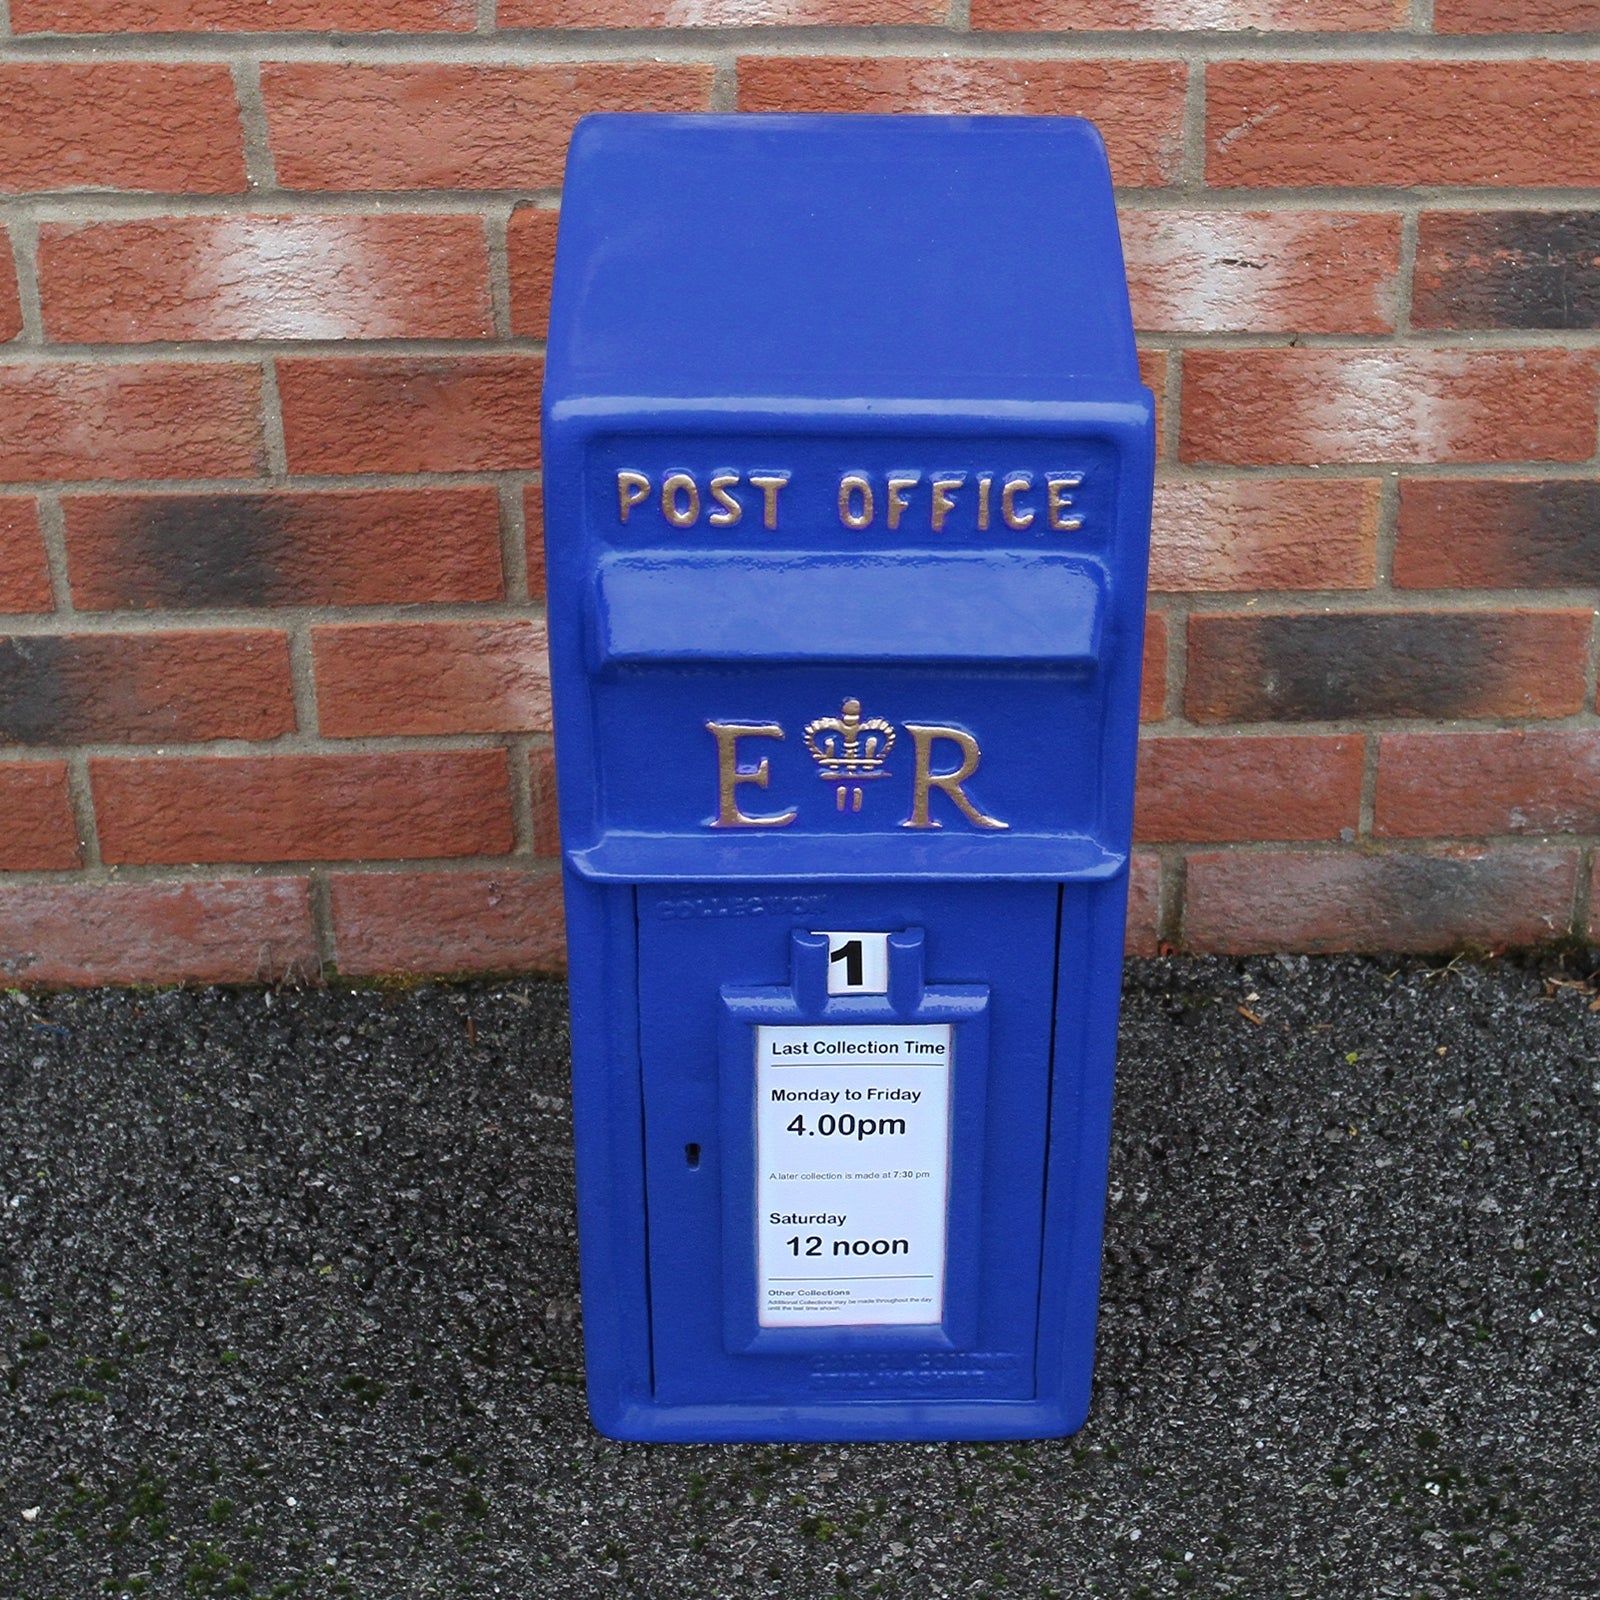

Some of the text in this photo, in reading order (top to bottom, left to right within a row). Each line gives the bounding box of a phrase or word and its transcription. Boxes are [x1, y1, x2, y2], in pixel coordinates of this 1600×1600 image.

[616, 469, 1082, 532] POST OFFICE
[705, 720, 799, 830] E
[901, 720, 1010, 830] R
[830, 940, 863, 986] 1
[773, 1041, 945, 1055] Last Collection Time
[772, 1089, 921, 1103] Monday to Friday
[787, 1114, 905, 1141] 4.00pm
[778, 1171, 799, 1181] later
[800, 1171, 843, 1181] collection
[844, 1171, 852, 1181] is
[854, 1171, 881, 1180] made
[882, 1171, 892, 1180] at
[893, 1170, 914, 1179] 7:30
[915, 1172, 931, 1180] pm
[770, 1213, 846, 1226] Saturday
[787, 1237, 908, 1256] 12 noon
[768, 1289, 851, 1297] Other Collections
